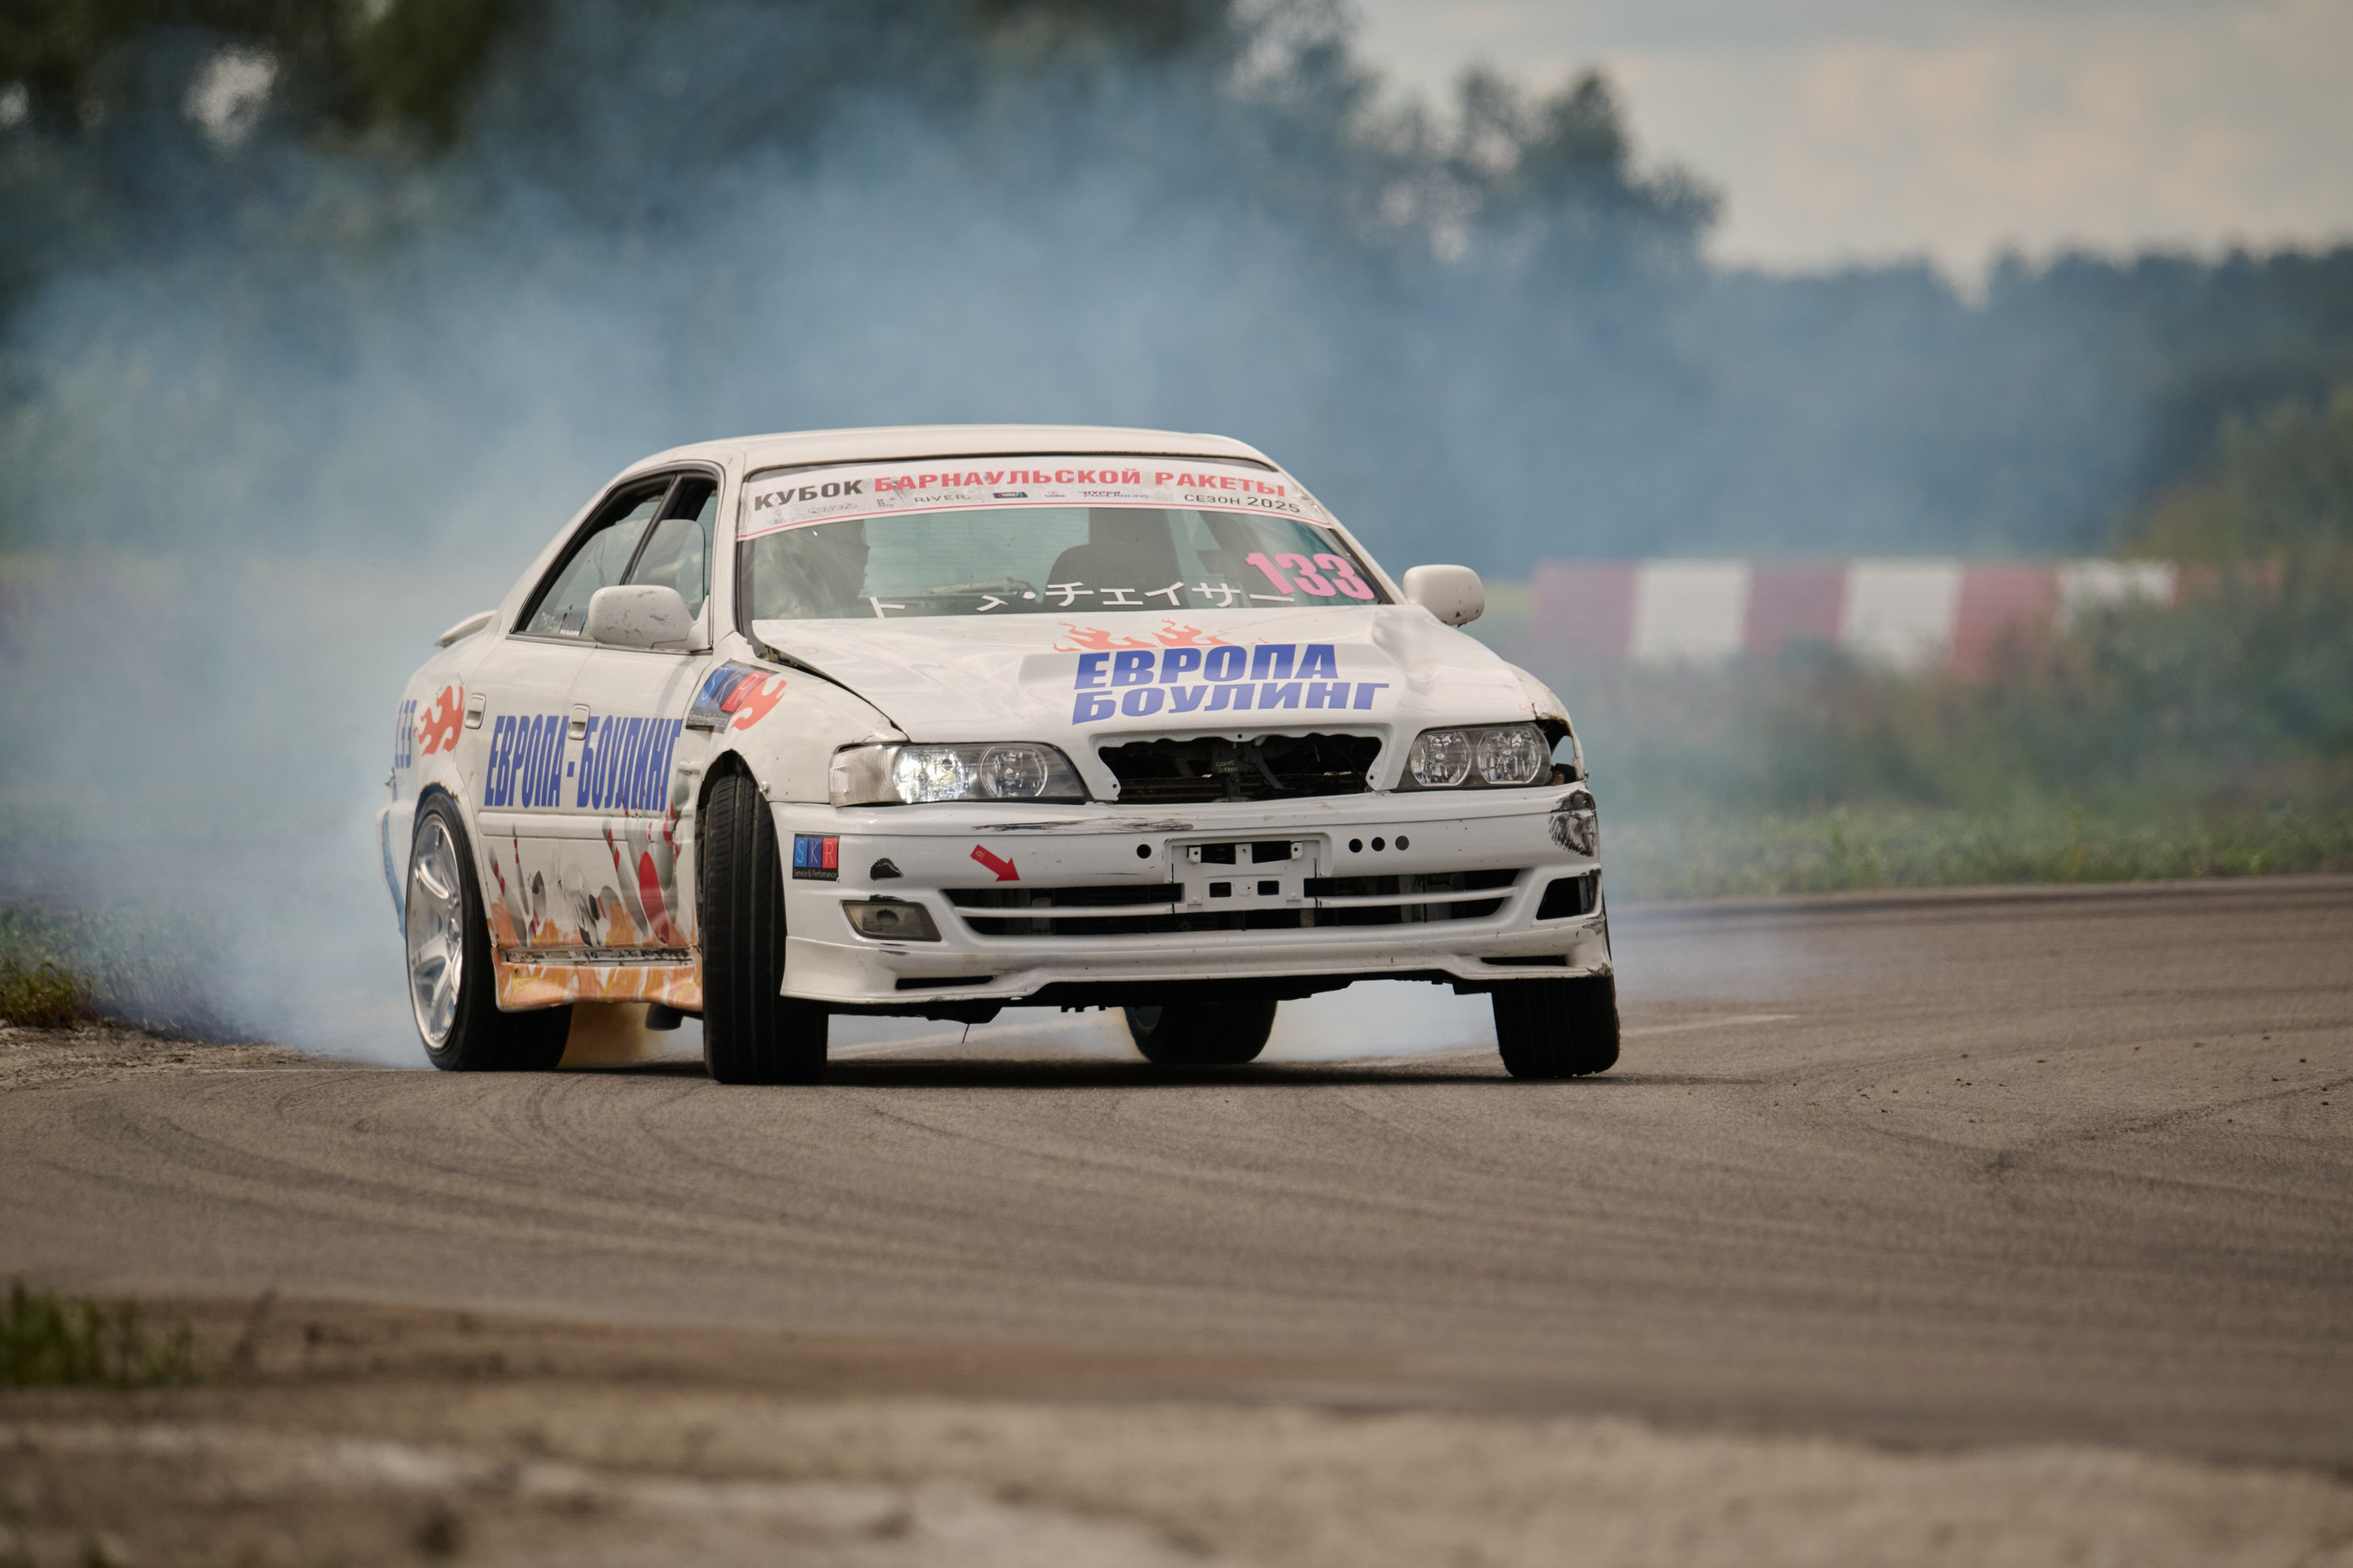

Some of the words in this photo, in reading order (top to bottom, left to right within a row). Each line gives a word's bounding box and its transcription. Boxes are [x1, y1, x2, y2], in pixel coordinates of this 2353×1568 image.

[754, 479, 863, 512] КУБОК
[874, 467, 1141, 493] БАРНАУЛЬСКОЙ
[1155, 472, 1285, 497] РАКЕТЫ
[915, 494, 972, 503] RIVER
[1184, 494, 1240, 505] СЕЗОН
[1247, 496, 1301, 513] 2025
[1245, 552, 1375, 600] 133
[701, 666, 760, 706] SKR
[1074, 644, 1339, 689] ЕВРОПА
[1072, 682, 1390, 725] БОУЛИНГ
[796, 840, 835, 865] SKR
